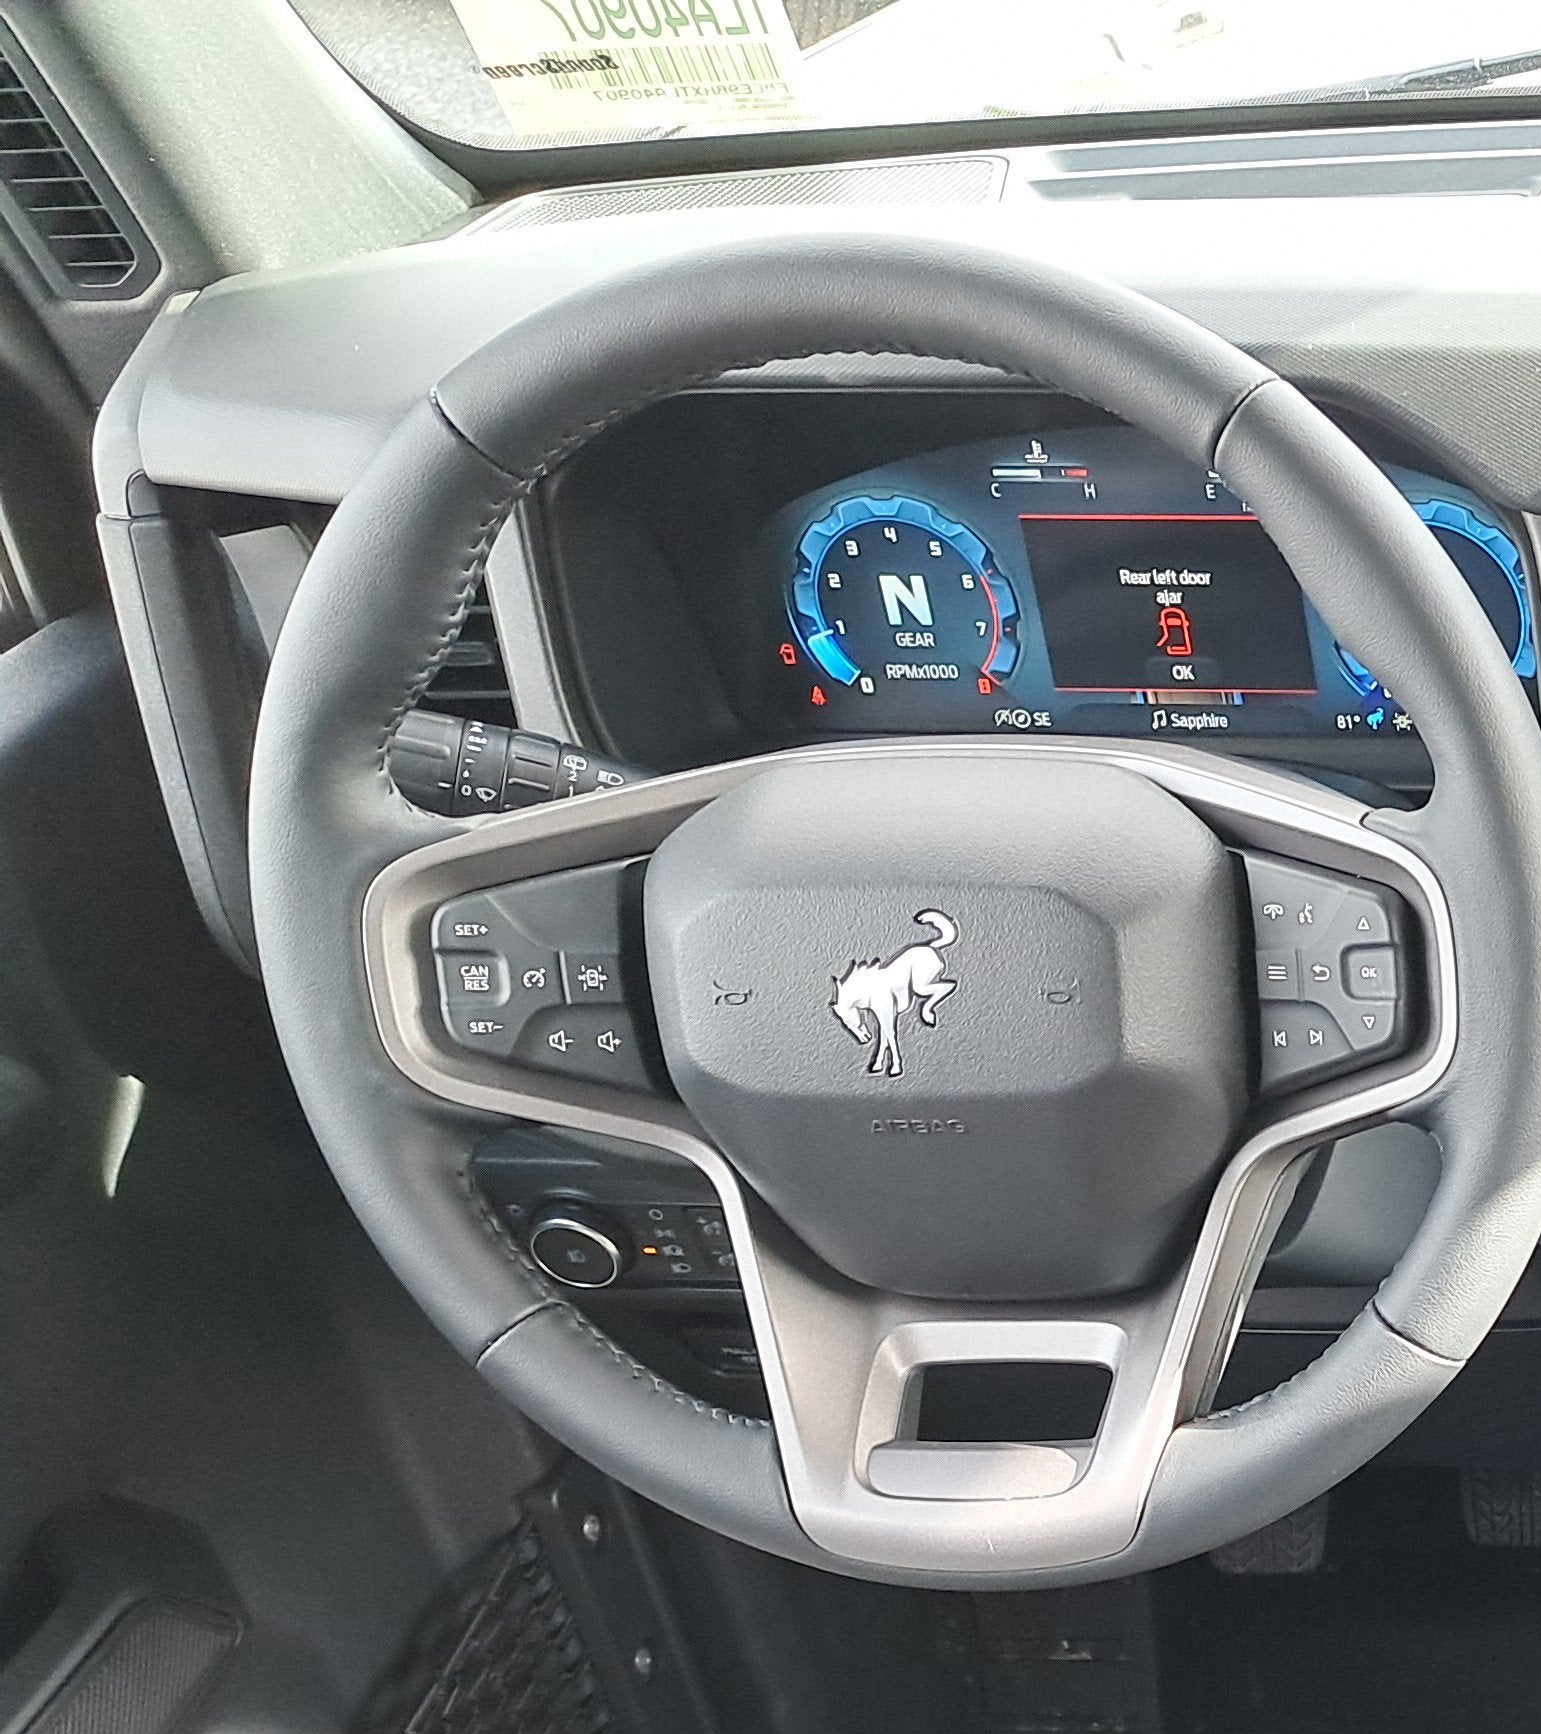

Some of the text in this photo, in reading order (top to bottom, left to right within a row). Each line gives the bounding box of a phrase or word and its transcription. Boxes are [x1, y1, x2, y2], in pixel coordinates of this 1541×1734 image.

[991, 482, 1002, 498] C
[1084, 483, 1096, 499] H
[1206, 484, 1216, 499] E
[883, 527, 897, 542] 4
[845, 541, 859, 556] 3
[929, 541, 942, 556] 5
[827, 573, 842, 588] 2
[961, 574, 975, 589] 6
[1119, 569, 1212, 585] Rear left door
[878, 575, 933, 626] N
[1156, 589, 1183, 606] ajar
[836, 620, 846, 635] 1
[975, 621, 986, 636] 7
[895, 632, 935, 648] GEAR
[885, 664, 959, 680] RPMx1000
[1172, 665, 1195, 681] OK
[859, 677, 874, 694] 0
[977, 678, 992, 694] 8
[1035, 713, 1052, 727] SE
[1171, 714, 1228, 730] Sapphire
[455, 923, 490, 937] SET+
[460, 965, 490, 978] CAN
[1361, 967, 1377, 979] OK
[463, 978, 490, 991] RES
[871, 1119, 965, 1134] AIRBAG
